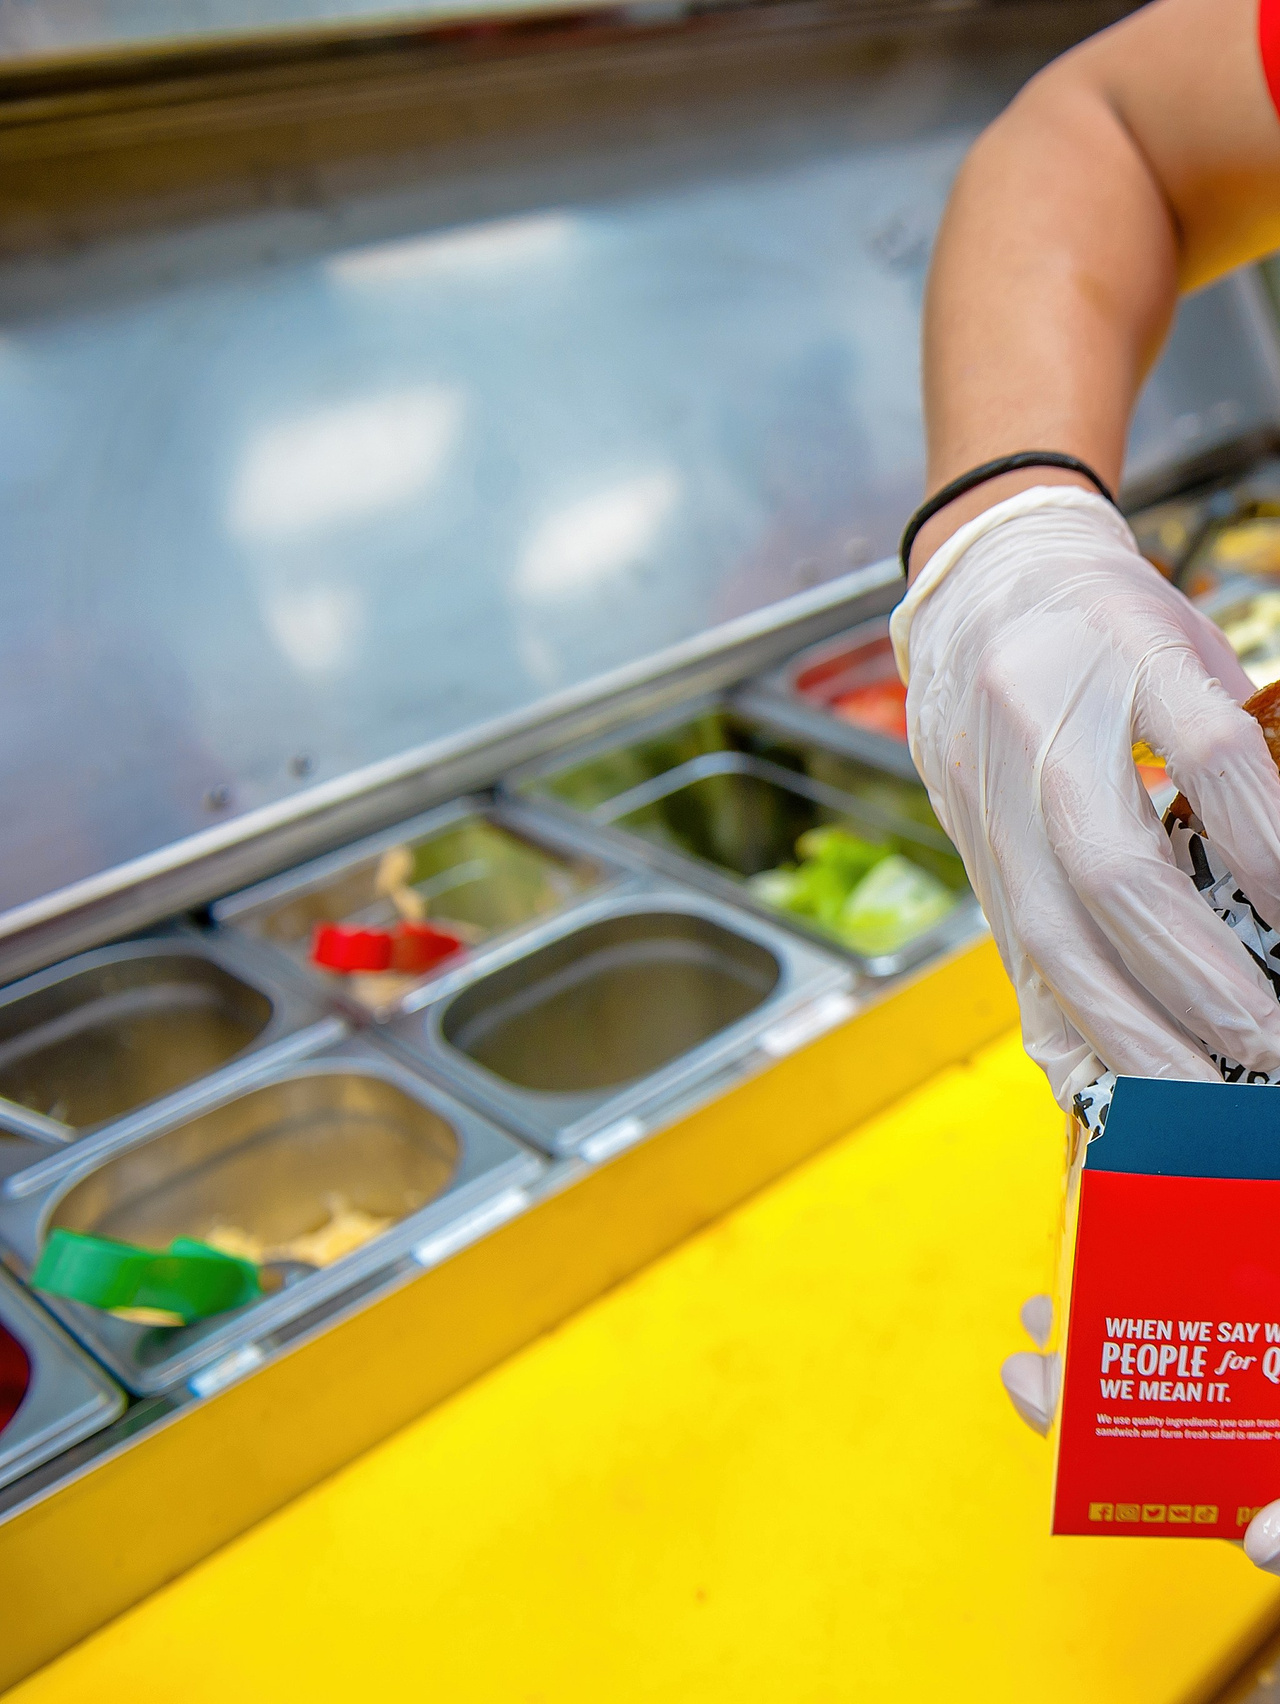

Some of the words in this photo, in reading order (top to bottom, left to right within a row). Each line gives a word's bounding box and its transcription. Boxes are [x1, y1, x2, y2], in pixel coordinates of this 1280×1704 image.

[1105, 1317, 1173, 1341] WHEN
[1178, 1320, 1213, 1342] WE
[1216, 1322, 1260, 1343] SAY
[1101, 1341, 1208, 1377] PEOPLE
[1214, 1349, 1258, 1376] for
[1099, 1378, 1134, 1400] WE
[1138, 1380, 1203, 1402] MEAN
[1206, 1382, 1232, 1403] IT.
[1095, 1427, 1140, 1438] sandwich
[1141, 1428, 1159, 1439] and
[1160, 1428, 1183, 1439] farm
[1184, 1428, 1209, 1440] fresh
[1210, 1429, 1236, 1440] salad
[1236, 1429, 1246, 1441] is
[1096, 1413, 1112, 1425] We
[1113, 1415, 1131, 1426] use
[1132, 1415, 1164, 1428] quality
[1165, 1416, 1219, 1429] ingredients
[1219, 1418, 1237, 1430] you
[1237, 1418, 1256, 1428] can
